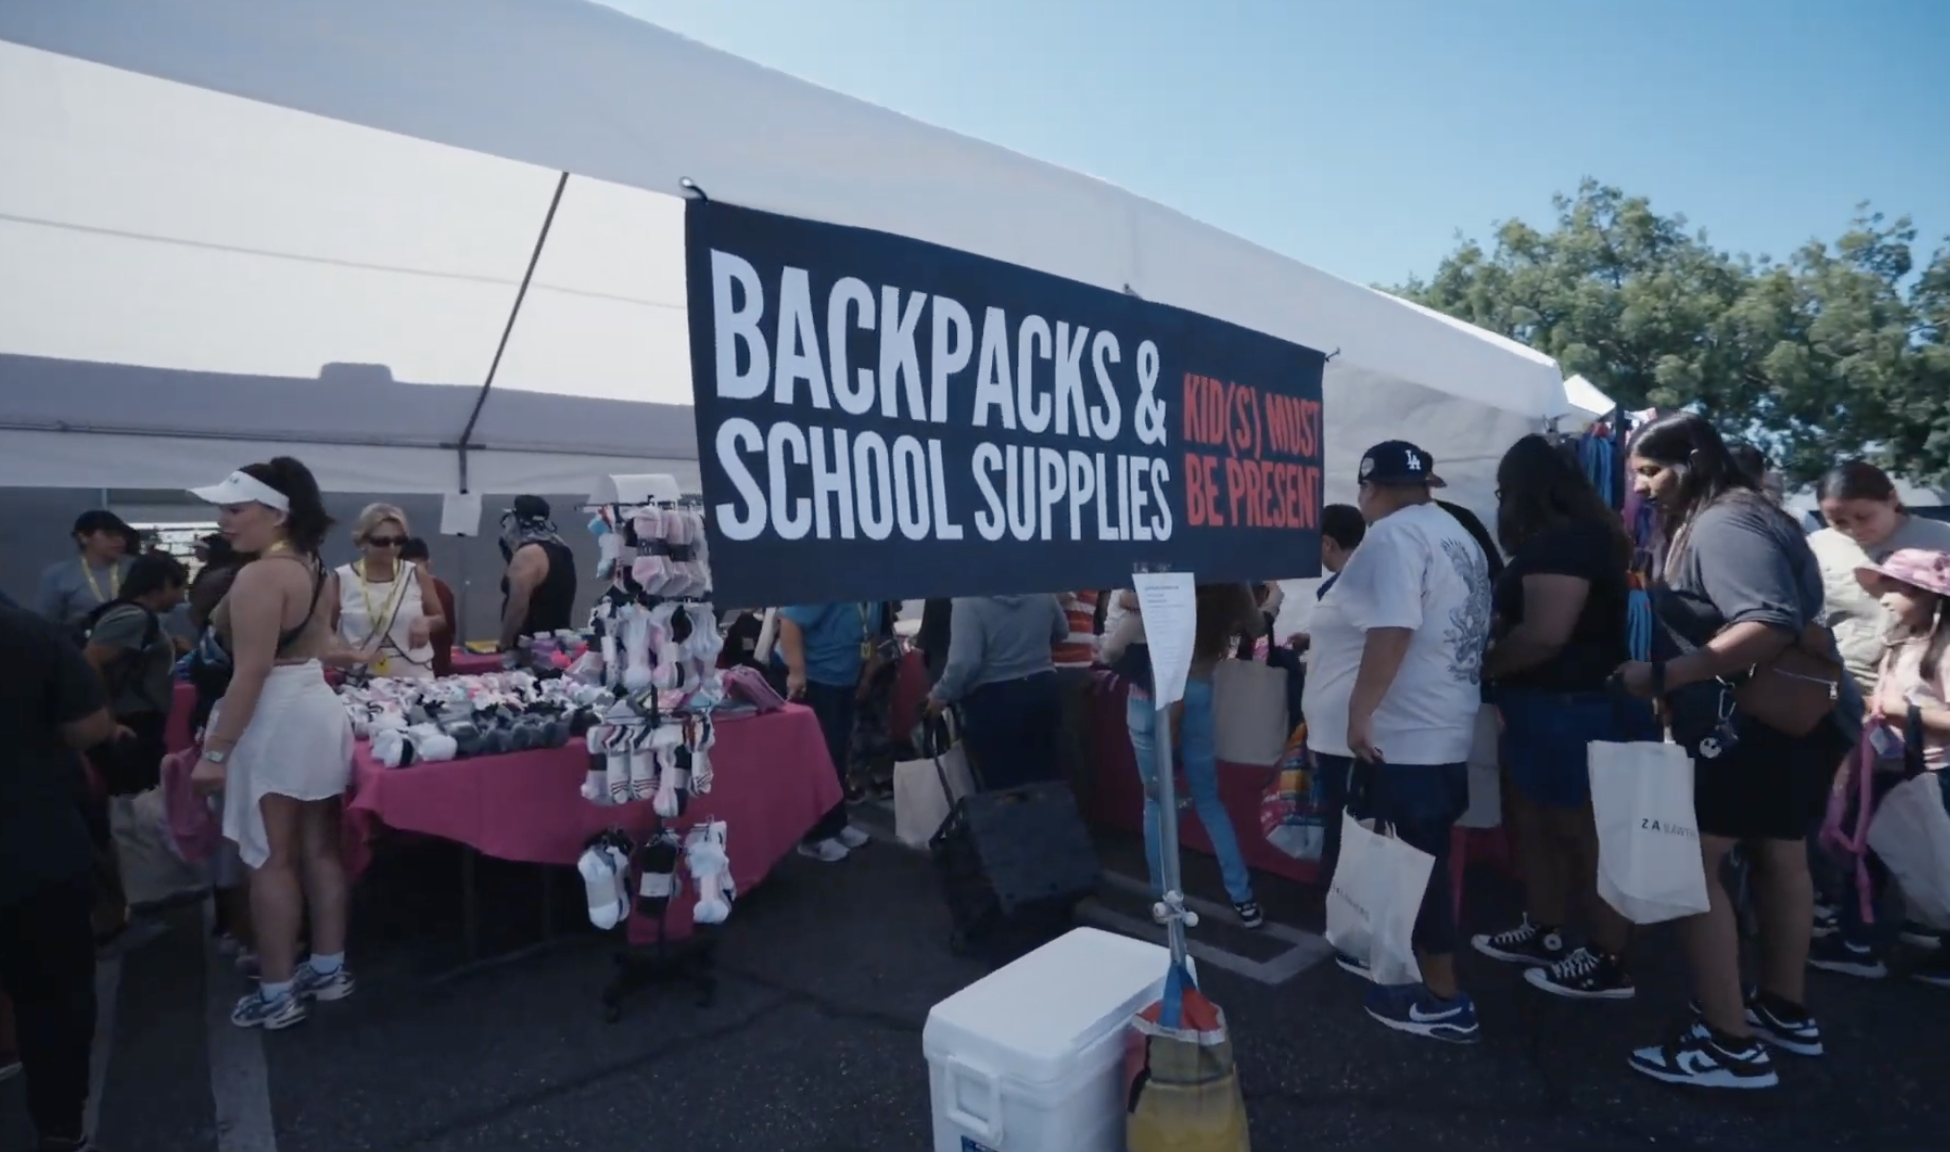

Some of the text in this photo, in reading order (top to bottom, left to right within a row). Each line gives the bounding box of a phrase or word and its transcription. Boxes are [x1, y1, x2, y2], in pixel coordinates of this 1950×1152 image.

[711, 248, 1167, 447] BACKPACKS &
[1184, 372, 1320, 459] KID(S) MUST
[716, 417, 1174, 541] SCHOOL SUPPLIES
[1186, 453, 1320, 529] BE PRESENT
[1406, 450, 1421, 470] LA
